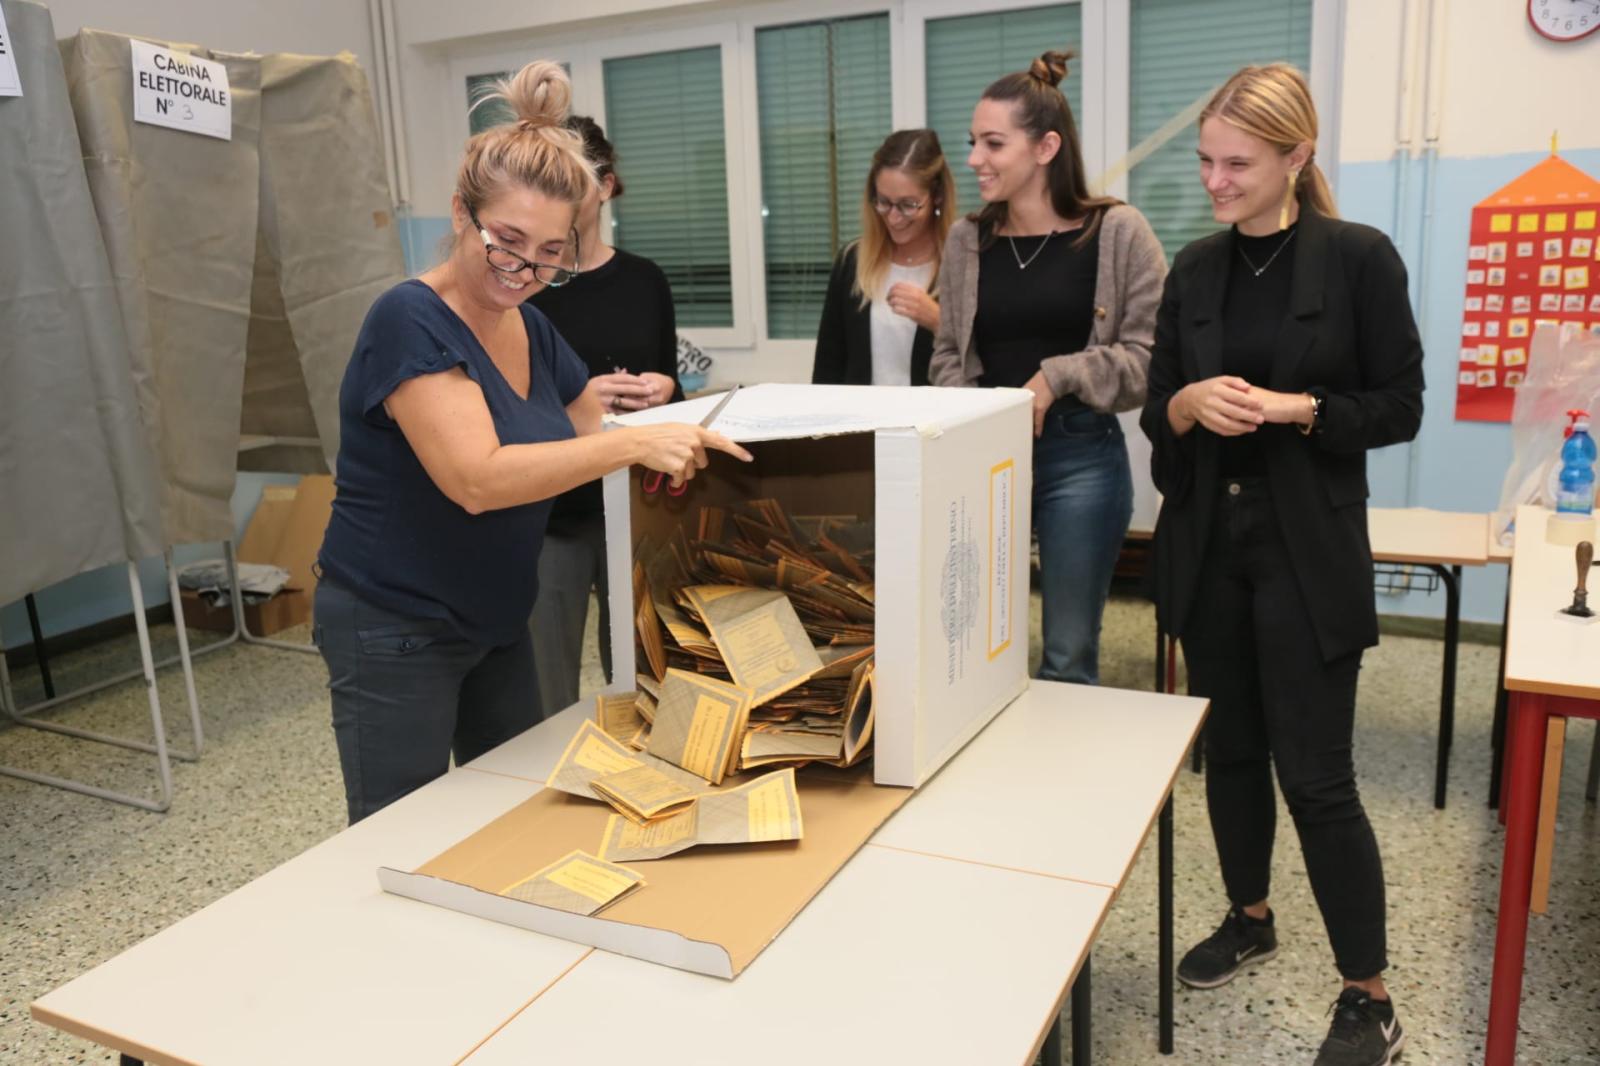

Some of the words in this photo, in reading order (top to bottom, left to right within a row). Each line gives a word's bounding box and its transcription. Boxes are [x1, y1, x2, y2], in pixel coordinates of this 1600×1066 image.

[1564, 20, 1573, 31] 6
[1580, 15, 1588, 26] 5
[153, 53, 212, 82] CABINA
[139, 71, 227, 107] ELETTORALE
[182, 104, 194, 121] 3
